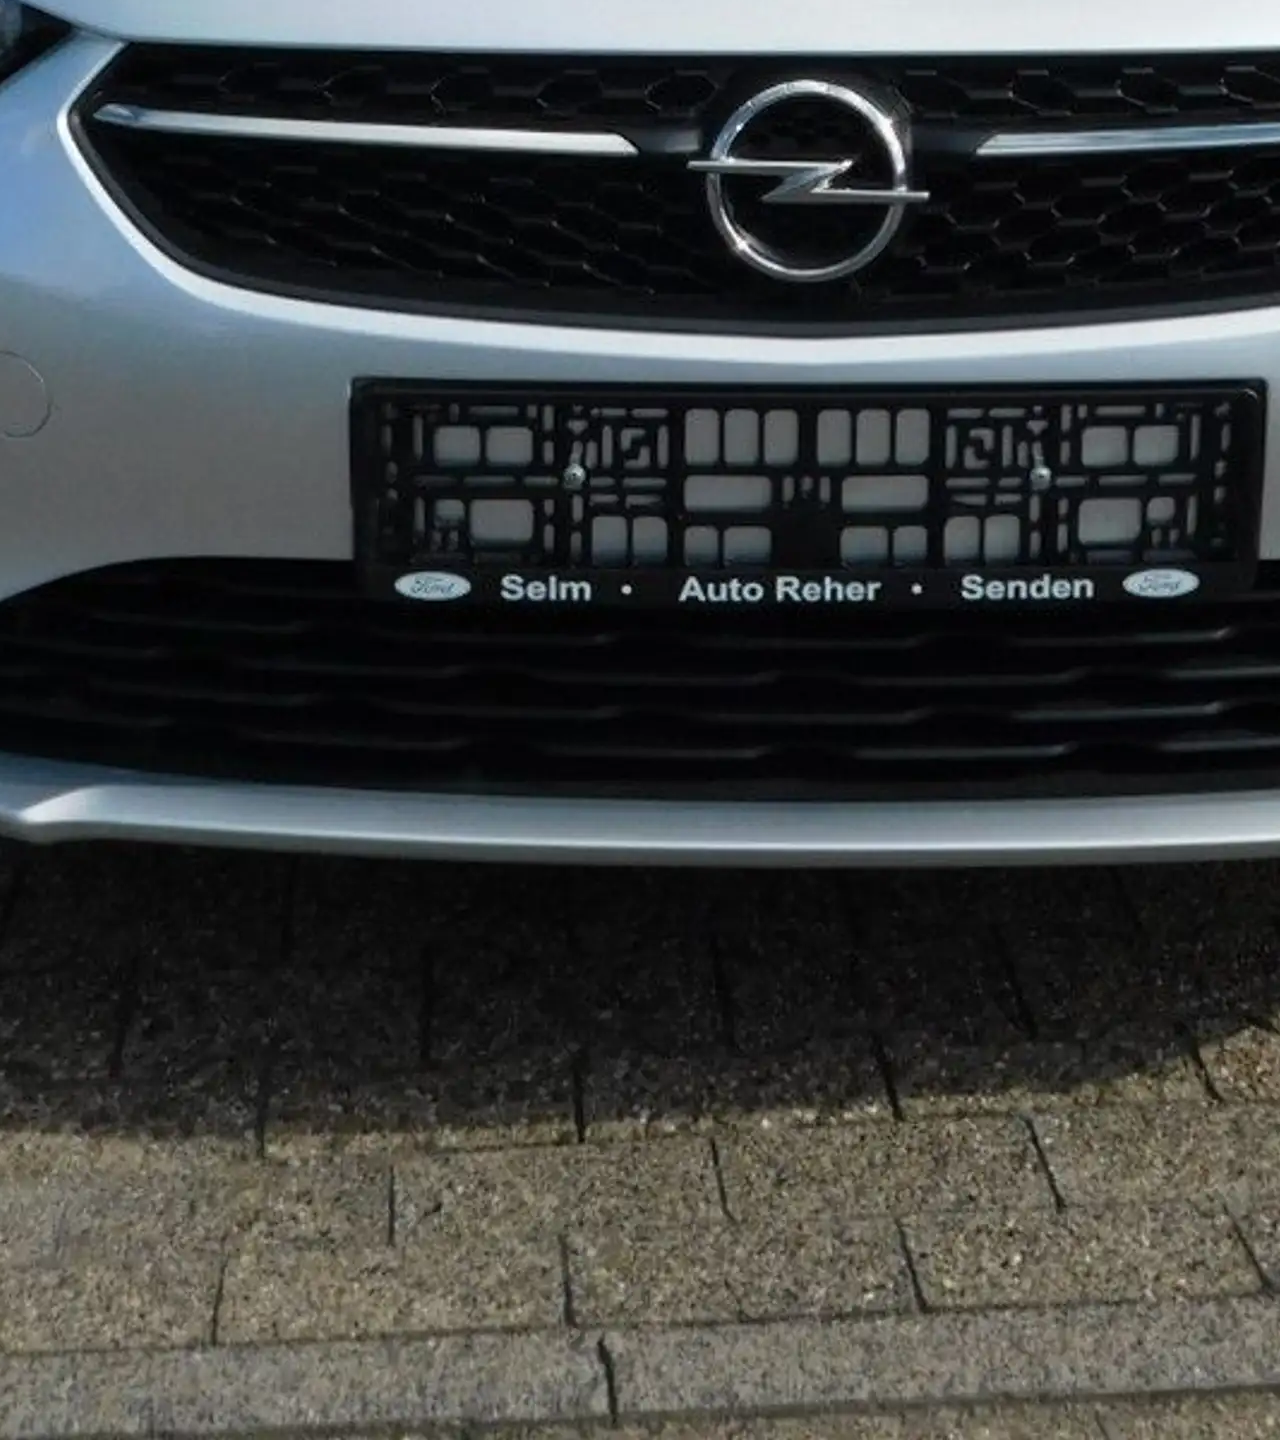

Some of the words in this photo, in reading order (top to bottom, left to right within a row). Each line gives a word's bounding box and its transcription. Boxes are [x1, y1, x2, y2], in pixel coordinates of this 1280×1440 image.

[499, 574, 593, 603] Selm
[677, 574, 766, 603] Auto
[775, 574, 883, 602] Reher
[959, 573, 1095, 601] Senden
